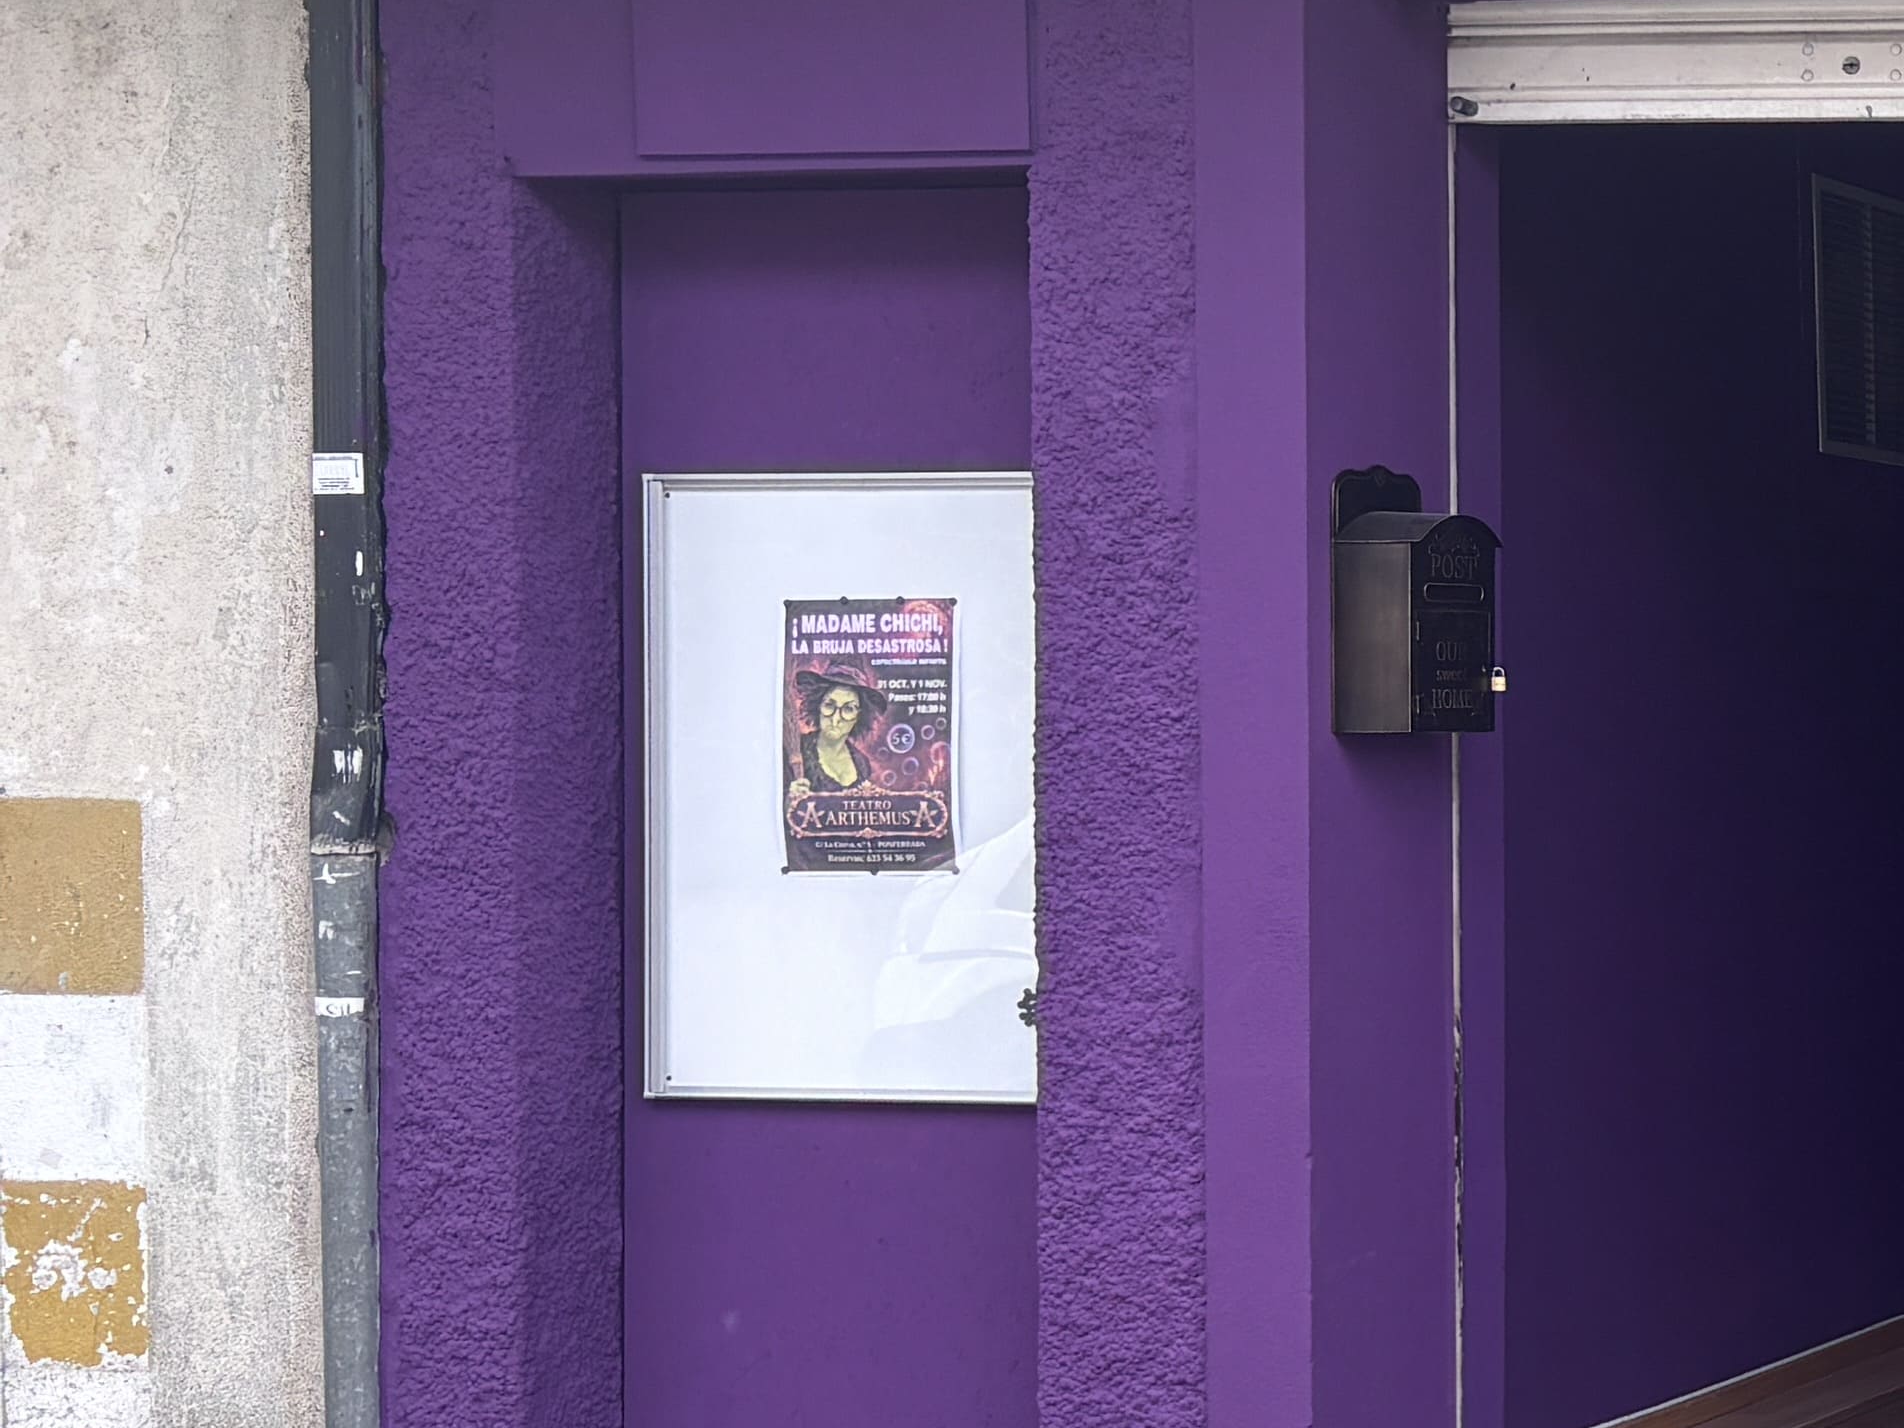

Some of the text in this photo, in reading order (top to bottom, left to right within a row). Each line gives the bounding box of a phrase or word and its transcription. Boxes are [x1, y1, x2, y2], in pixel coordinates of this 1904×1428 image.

[1432, 553, 1478, 579] POST
[880, 613, 943, 636] CHICHI,
[791, 640, 809, 654] LA
[813, 639, 855, 654] BRUJA
[842, 800, 892, 810] TEATRO
[825, 811, 911, 826] ARTHEMUS
